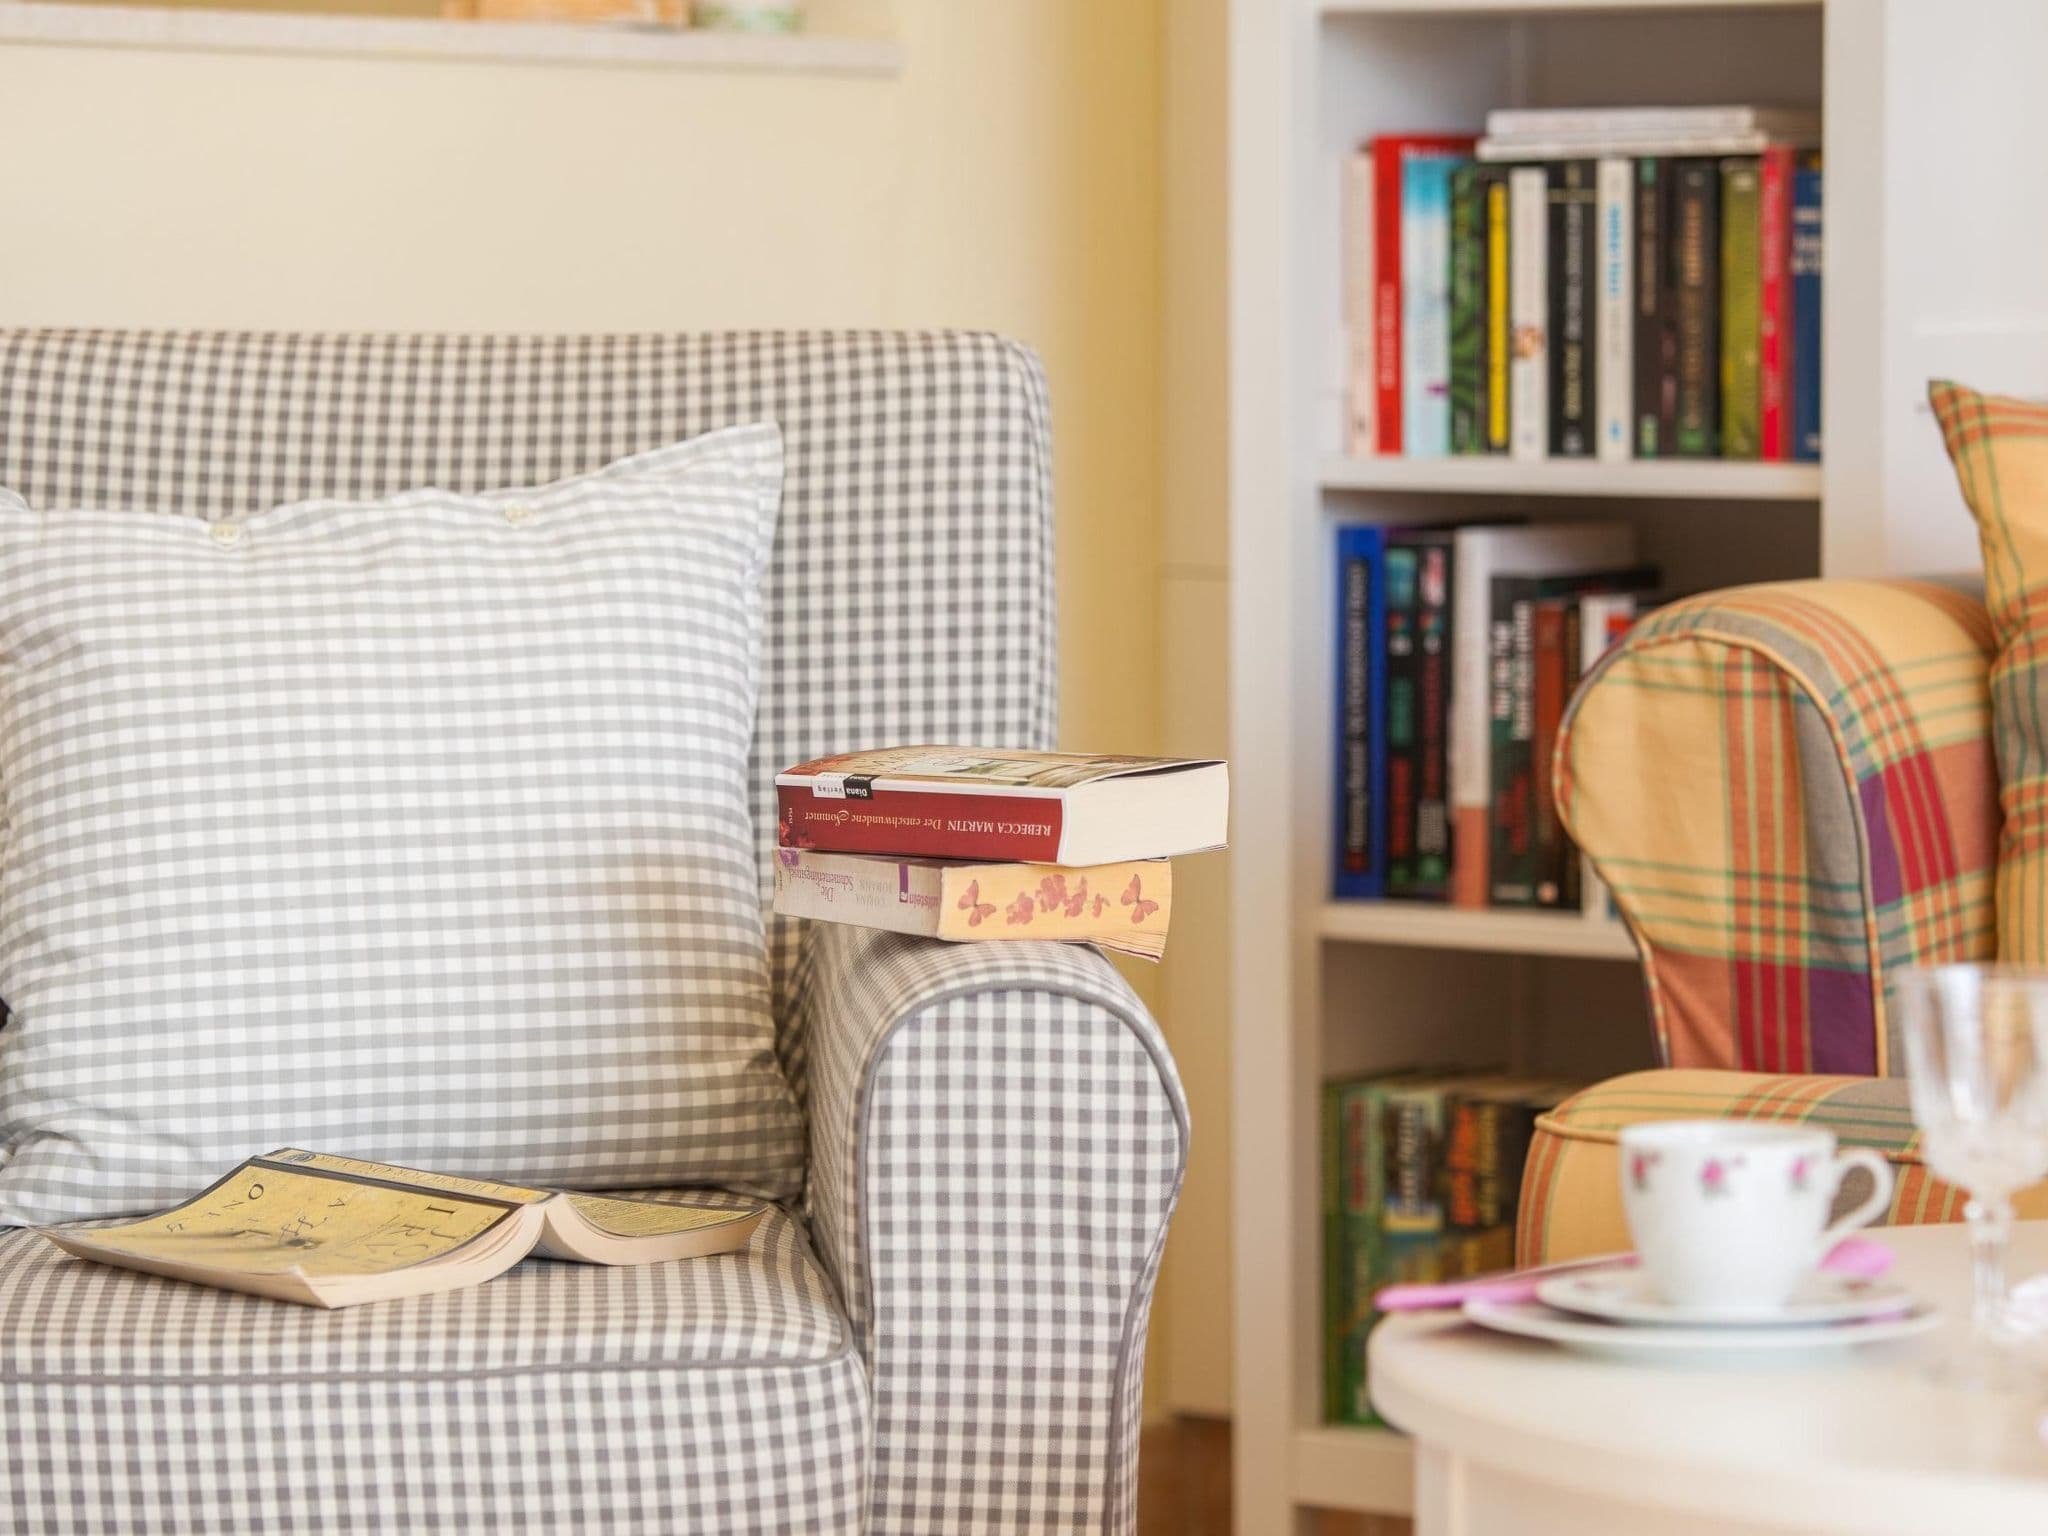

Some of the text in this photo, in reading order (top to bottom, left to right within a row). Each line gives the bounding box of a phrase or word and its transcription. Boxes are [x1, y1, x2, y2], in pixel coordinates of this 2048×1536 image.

[846, 786, 868, 797] Diana
[804, 810, 850, 827] Sommer
[851, 812, 921, 829] entschwundene
[923, 819, 941, 831] Der
[947, 820, 994, 834] MARTIN
[997, 822, 1051, 836] REBECCA
[820, 886, 834, 902] Die
